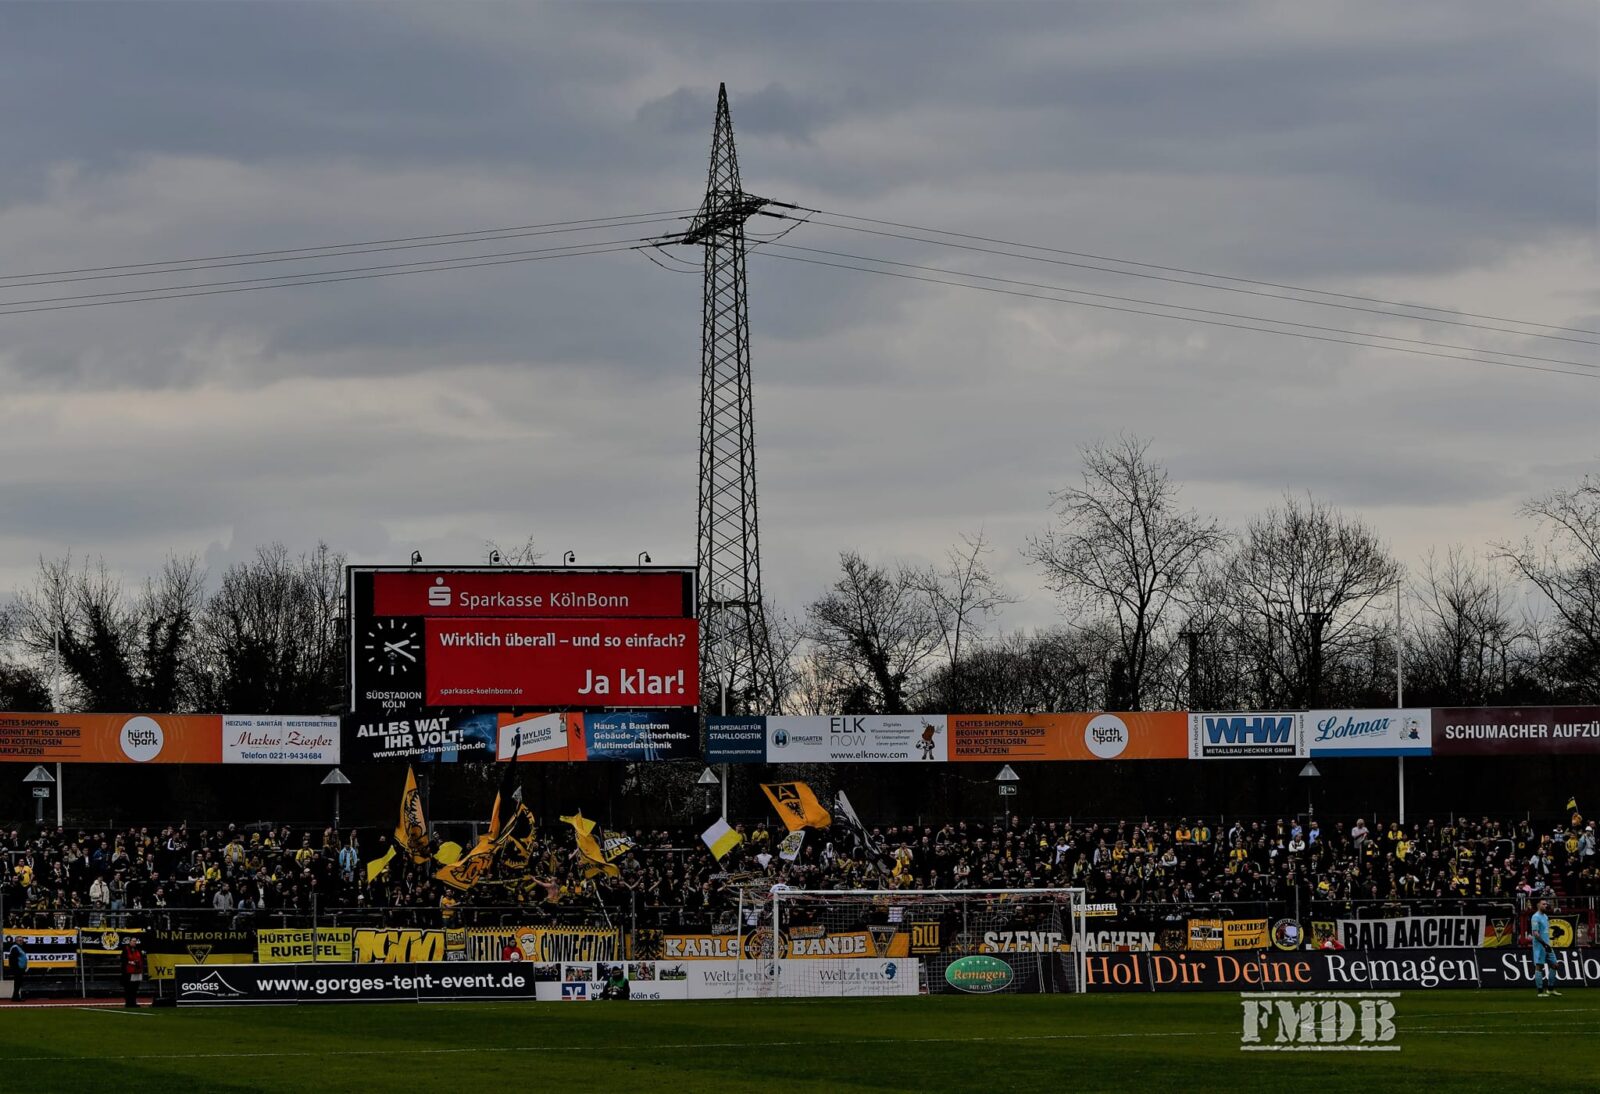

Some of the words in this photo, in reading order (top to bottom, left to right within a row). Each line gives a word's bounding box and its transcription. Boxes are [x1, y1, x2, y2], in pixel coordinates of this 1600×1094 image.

[460, 592, 542, 608] Sparkasse
[550, 592, 629, 606] KölnBonn
[440, 632, 500, 647] Wirklich
[505, 632, 556, 647] überall
[572, 632, 600, 646] und
[604, 635, 622, 646] so
[625, 632, 686, 647] einfach?
[578, 669, 610, 695] Ja
[620, 668, 685, 695] klar!
[366, 689, 422, 700] SÜDSTADION
[440, 687, 524, 697] sparkasse-koelnbonn.de
[382, 699, 406, 708] KÖLN
[356, 720, 410, 738] ALLES
[414, 717, 450, 732] WAT
[594, 722, 618, 730] Haus-
[621, 722, 627, 730] &
[628, 722, 670, 730] Baustrom
[830, 717, 866, 733] ELK
[956, 720, 983, 728] ECHTES
[1314, 716, 1390, 742] Lohmar
[1445, 724, 1548, 740] SCHUMACHER
[1552, 720, 1600, 738] AUFZÜ
[128, 730, 154, 740] hürth
[522, 728, 552, 740] MYLIUS
[1092, 728, 1120, 738] hürth
[1205, 717, 1293, 744] WHM
[134, 737, 158, 748] park
[230, 731, 281, 747] Markus
[285, 731, 333, 748] Ziegler
[384, 734, 414, 749] IHR
[417, 730, 464, 746] VOLT!
[522, 735, 552, 746] INNOVATION
[830, 734, 867, 746] now
[956, 738, 973, 746] UND
[974, 738, 1027, 746] KOSTENLOSEN
[1099, 734, 1123, 744] park
[241, 751, 268, 760] Telefon
[269, 752, 322, 760] 0221-9434684
[372, 742, 486, 758] www.mylius-innovation.de
[830, 750, 908, 759] www.elknow.com
[156, 930, 168, 940] IN
[171, 930, 248, 941] MEMORIAM
[1344, 922, 1388, 950] BAD
[1393, 918, 1481, 948] AACHEN
[666, 938, 740, 957] KARLS
[793, 935, 867, 956] BANDE
[984, 930, 1062, 953] SZENE
[271, 945, 341, 957] RUREFEL
[820, 968, 879, 981] Weltzien
[954, 970, 1006, 983] Remagen
[1086, 954, 1144, 985] Hol
[1152, 954, 1206, 984] Dir
[1214, 953, 1312, 984] Deine
[1324, 954, 1478, 988] Remagen
[182, 982, 220, 991] GORGES
[256, 972, 526, 994] www.gorges-tent-event.de
[650, 992, 660, 1000] eG
